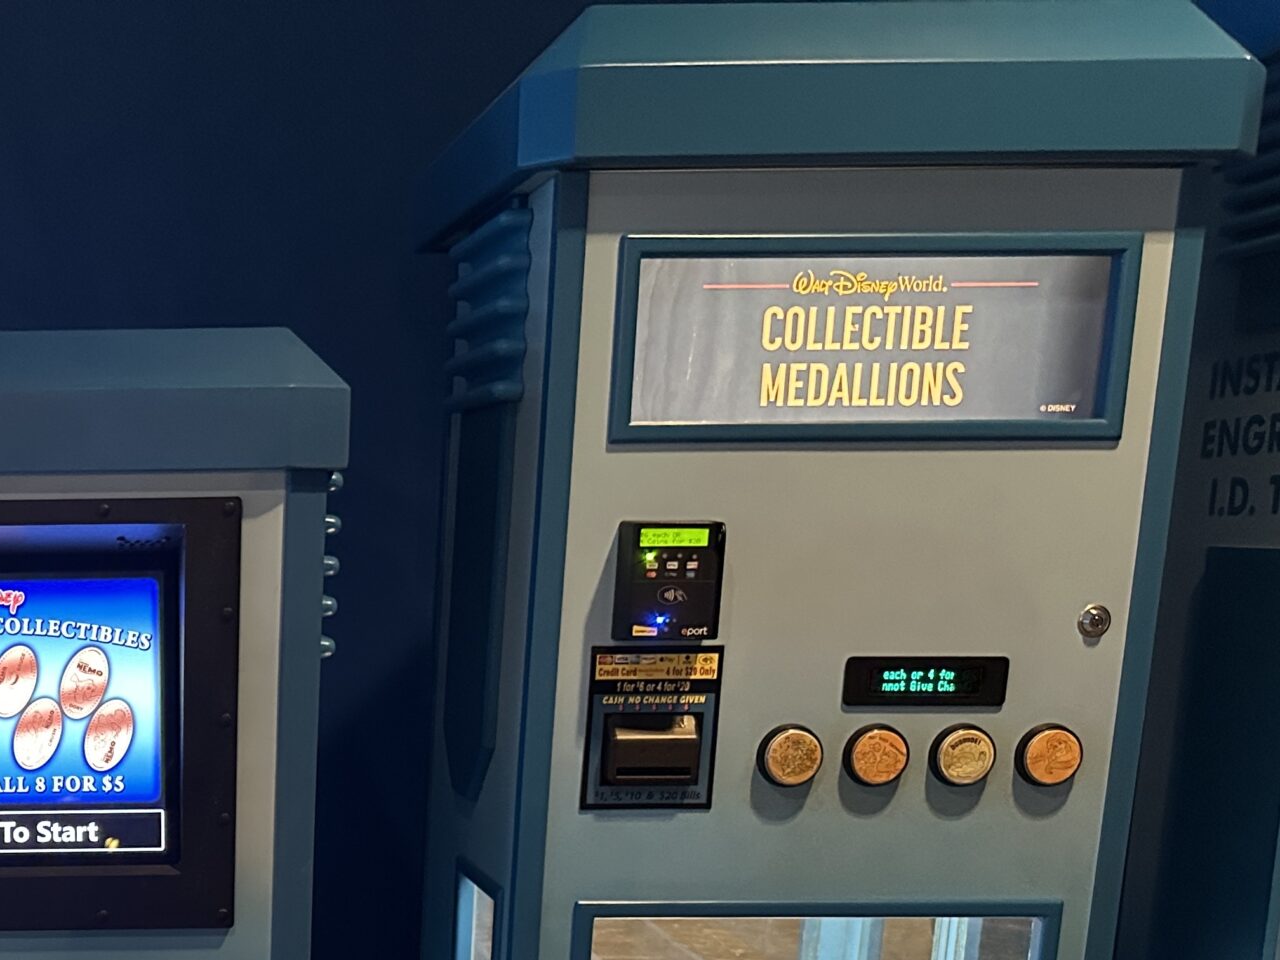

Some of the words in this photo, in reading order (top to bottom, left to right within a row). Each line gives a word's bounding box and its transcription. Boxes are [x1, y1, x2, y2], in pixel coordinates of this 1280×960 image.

[829, 270, 897, 301] Disney
[761, 304, 973, 351] COLLECTIBLE
[1209, 351, 1280, 400] INST
[759, 361, 966, 407] MEDALLIONS
[1048, 404, 1076, 412] DISNEY
[1208, 475, 1256, 517] I.D.
[77, 662, 103, 677] NEMO
[598, 667, 620, 677] Credit
[621, 667, 637, 676] Card
[672, 665, 684, 676] for
[699, 665, 716, 677] Only
[883, 668, 907, 680] each
[911, 671, 924, 680] or
[927, 668, 935, 680] 4
[623, 682, 636, 692] for
[646, 683, 655, 691] or
[656, 682, 662, 691] 4
[663, 682, 676, 691] for
[882, 680, 906, 691] nnot
[602, 695, 624, 704] CASH
[628, 695, 642, 704] NO
[643, 695, 677, 703] CHANGE
[679, 695, 706, 703] GIVEN
[35, 776, 45, 793] 8
[52, 775, 97, 792] FOR
[102, 774, 125, 792] $5
[679, 791, 702, 800] Bills
[36, 820, 99, 843] Start
